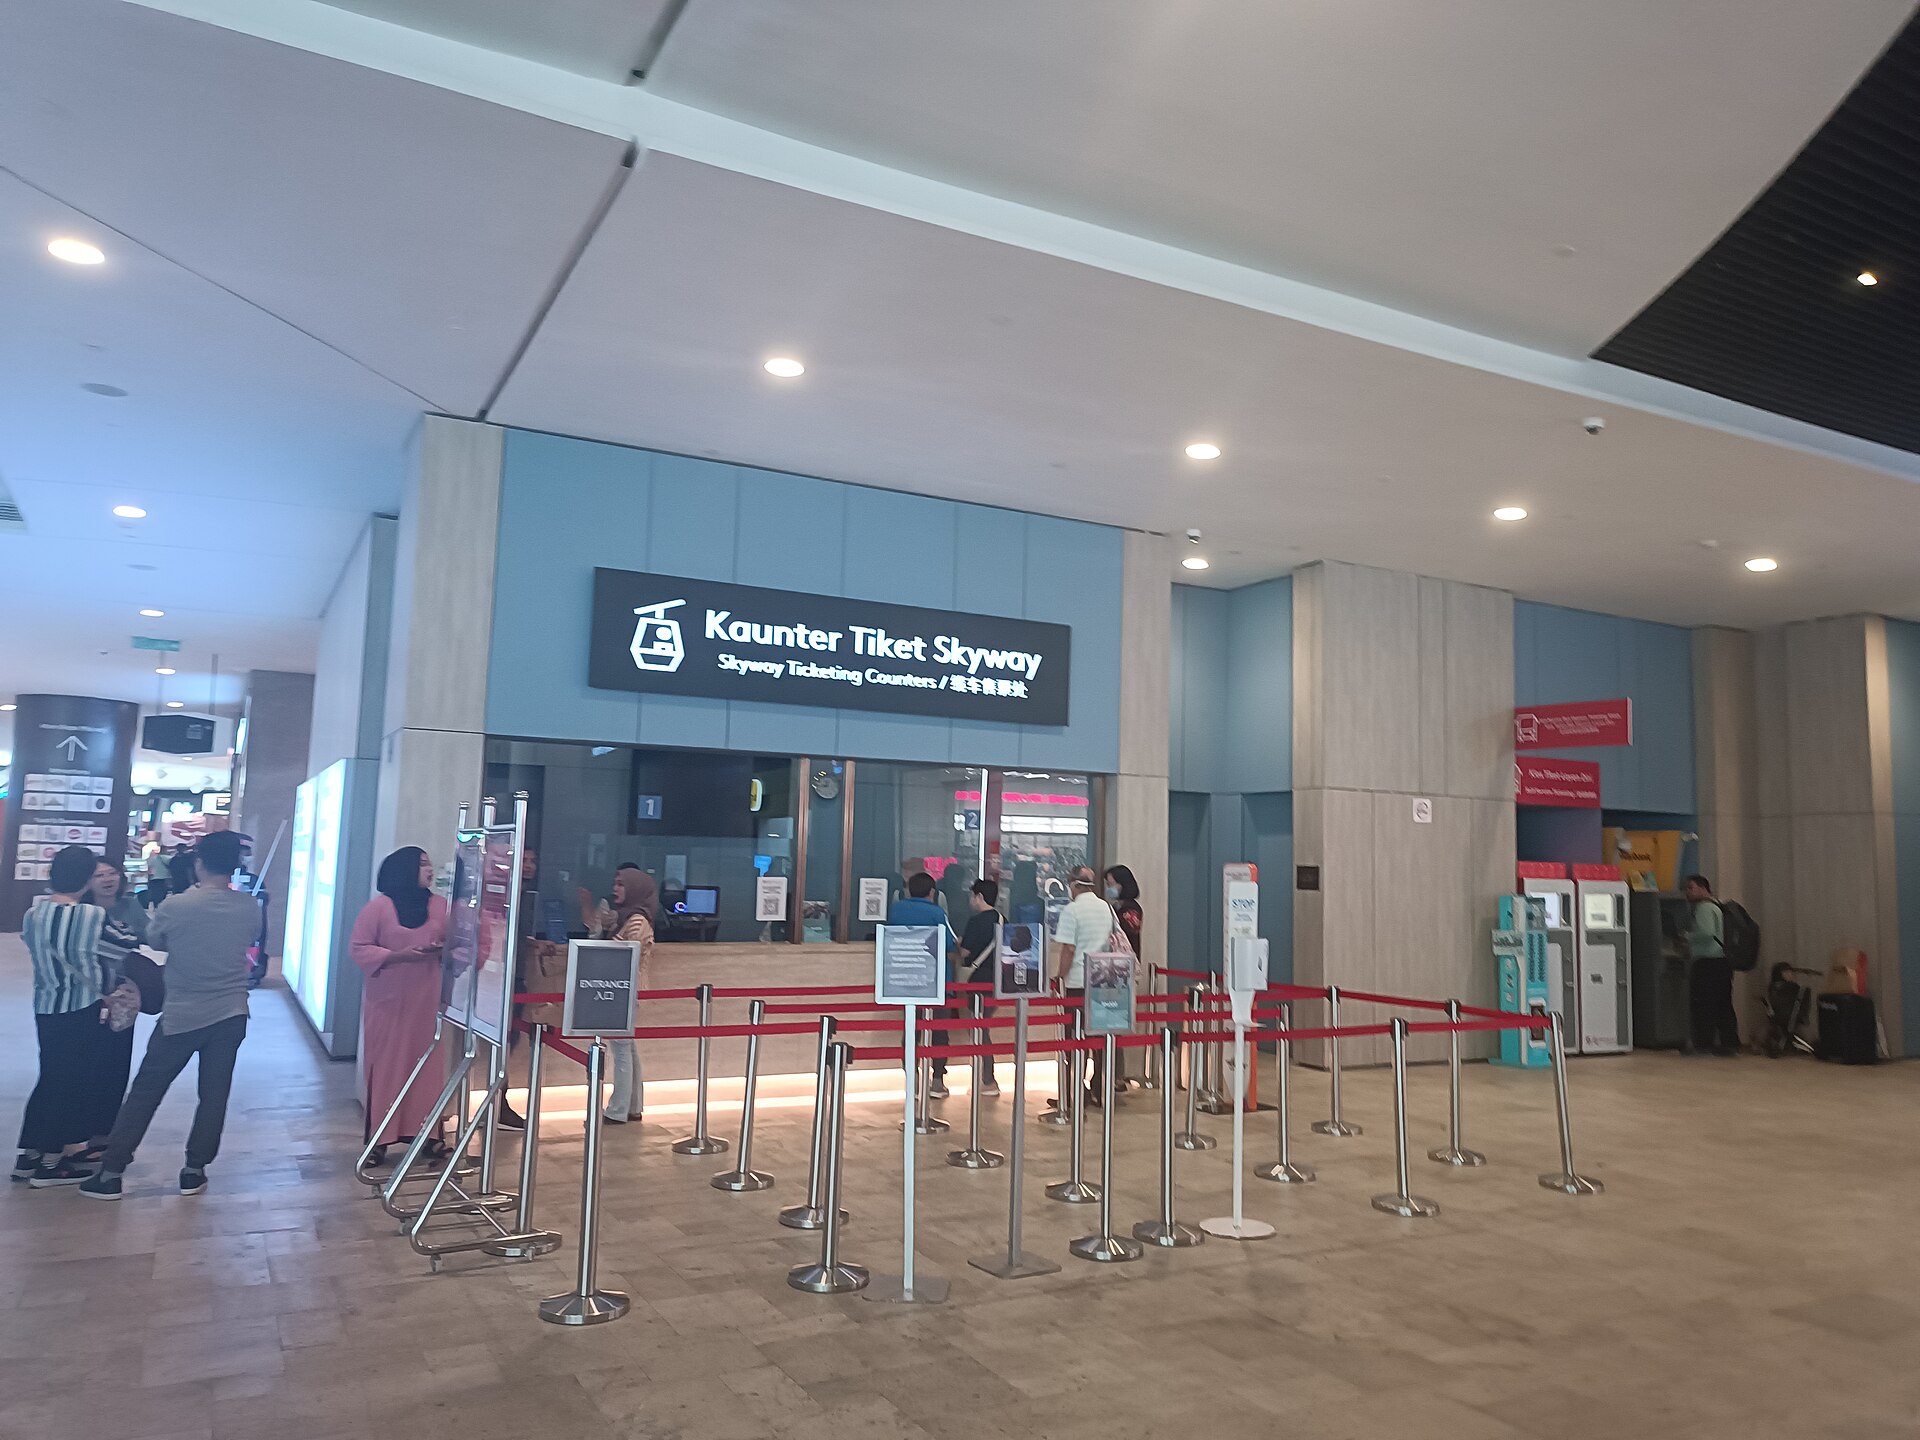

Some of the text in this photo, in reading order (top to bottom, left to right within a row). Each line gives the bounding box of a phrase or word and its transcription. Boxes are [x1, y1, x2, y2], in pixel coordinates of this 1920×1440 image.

[704, 608, 1043, 681] Kaunter Tiket Skyway
[717, 653, 786, 679] Skyway
[785, 659, 864, 687] Ticketing
[864, 668, 938, 690] Counters
[645, 798, 655, 816] 1
[967, 811, 979, 829] 2
[579, 979, 631, 989] ENTRANCE
